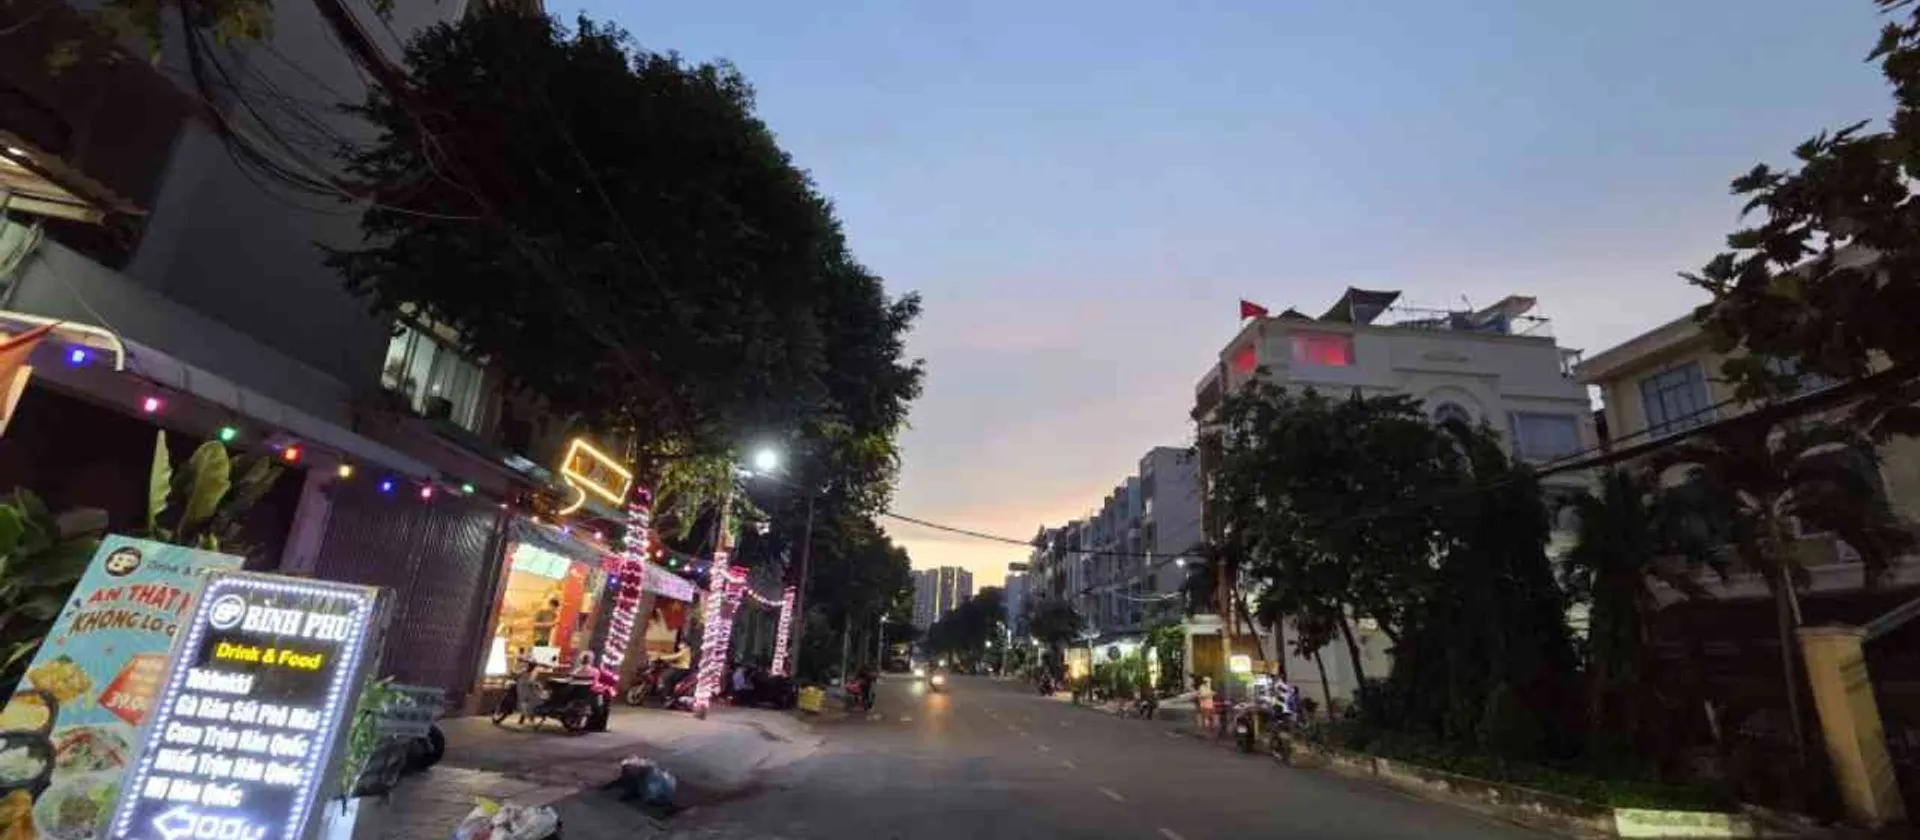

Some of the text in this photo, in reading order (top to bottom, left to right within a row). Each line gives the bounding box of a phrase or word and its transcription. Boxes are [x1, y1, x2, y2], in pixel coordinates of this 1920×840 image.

[216, 641, 323, 670] Drink & Food
